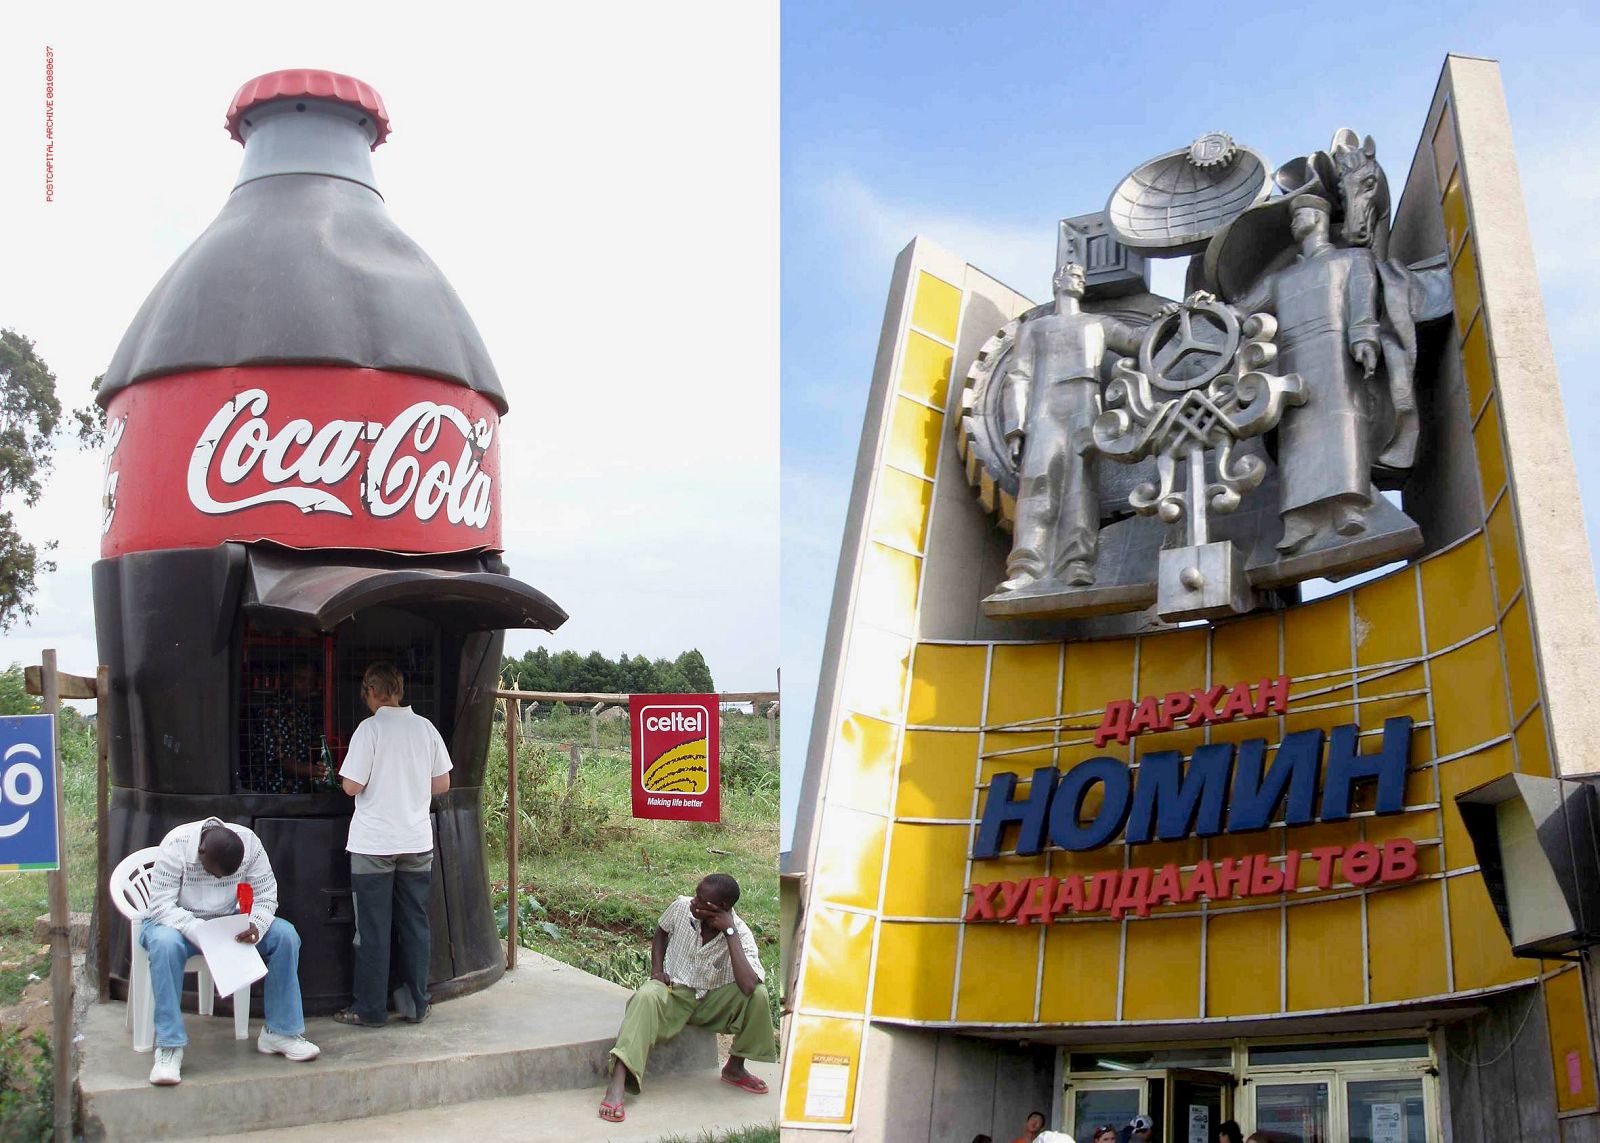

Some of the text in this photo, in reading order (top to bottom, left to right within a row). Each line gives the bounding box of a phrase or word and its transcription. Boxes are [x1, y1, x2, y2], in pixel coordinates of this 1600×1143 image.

[187, 388, 493, 530] Coca-Cola
[646, 711, 702, 732] celtel
[1094, 675, 1291, 748] ДАРХАН
[647, 797, 704, 808] Making life better
[973, 715, 1414, 861] НОМИН
[966, 837, 1419, 926] ХУДАЛДААНЫ ТӨВ
